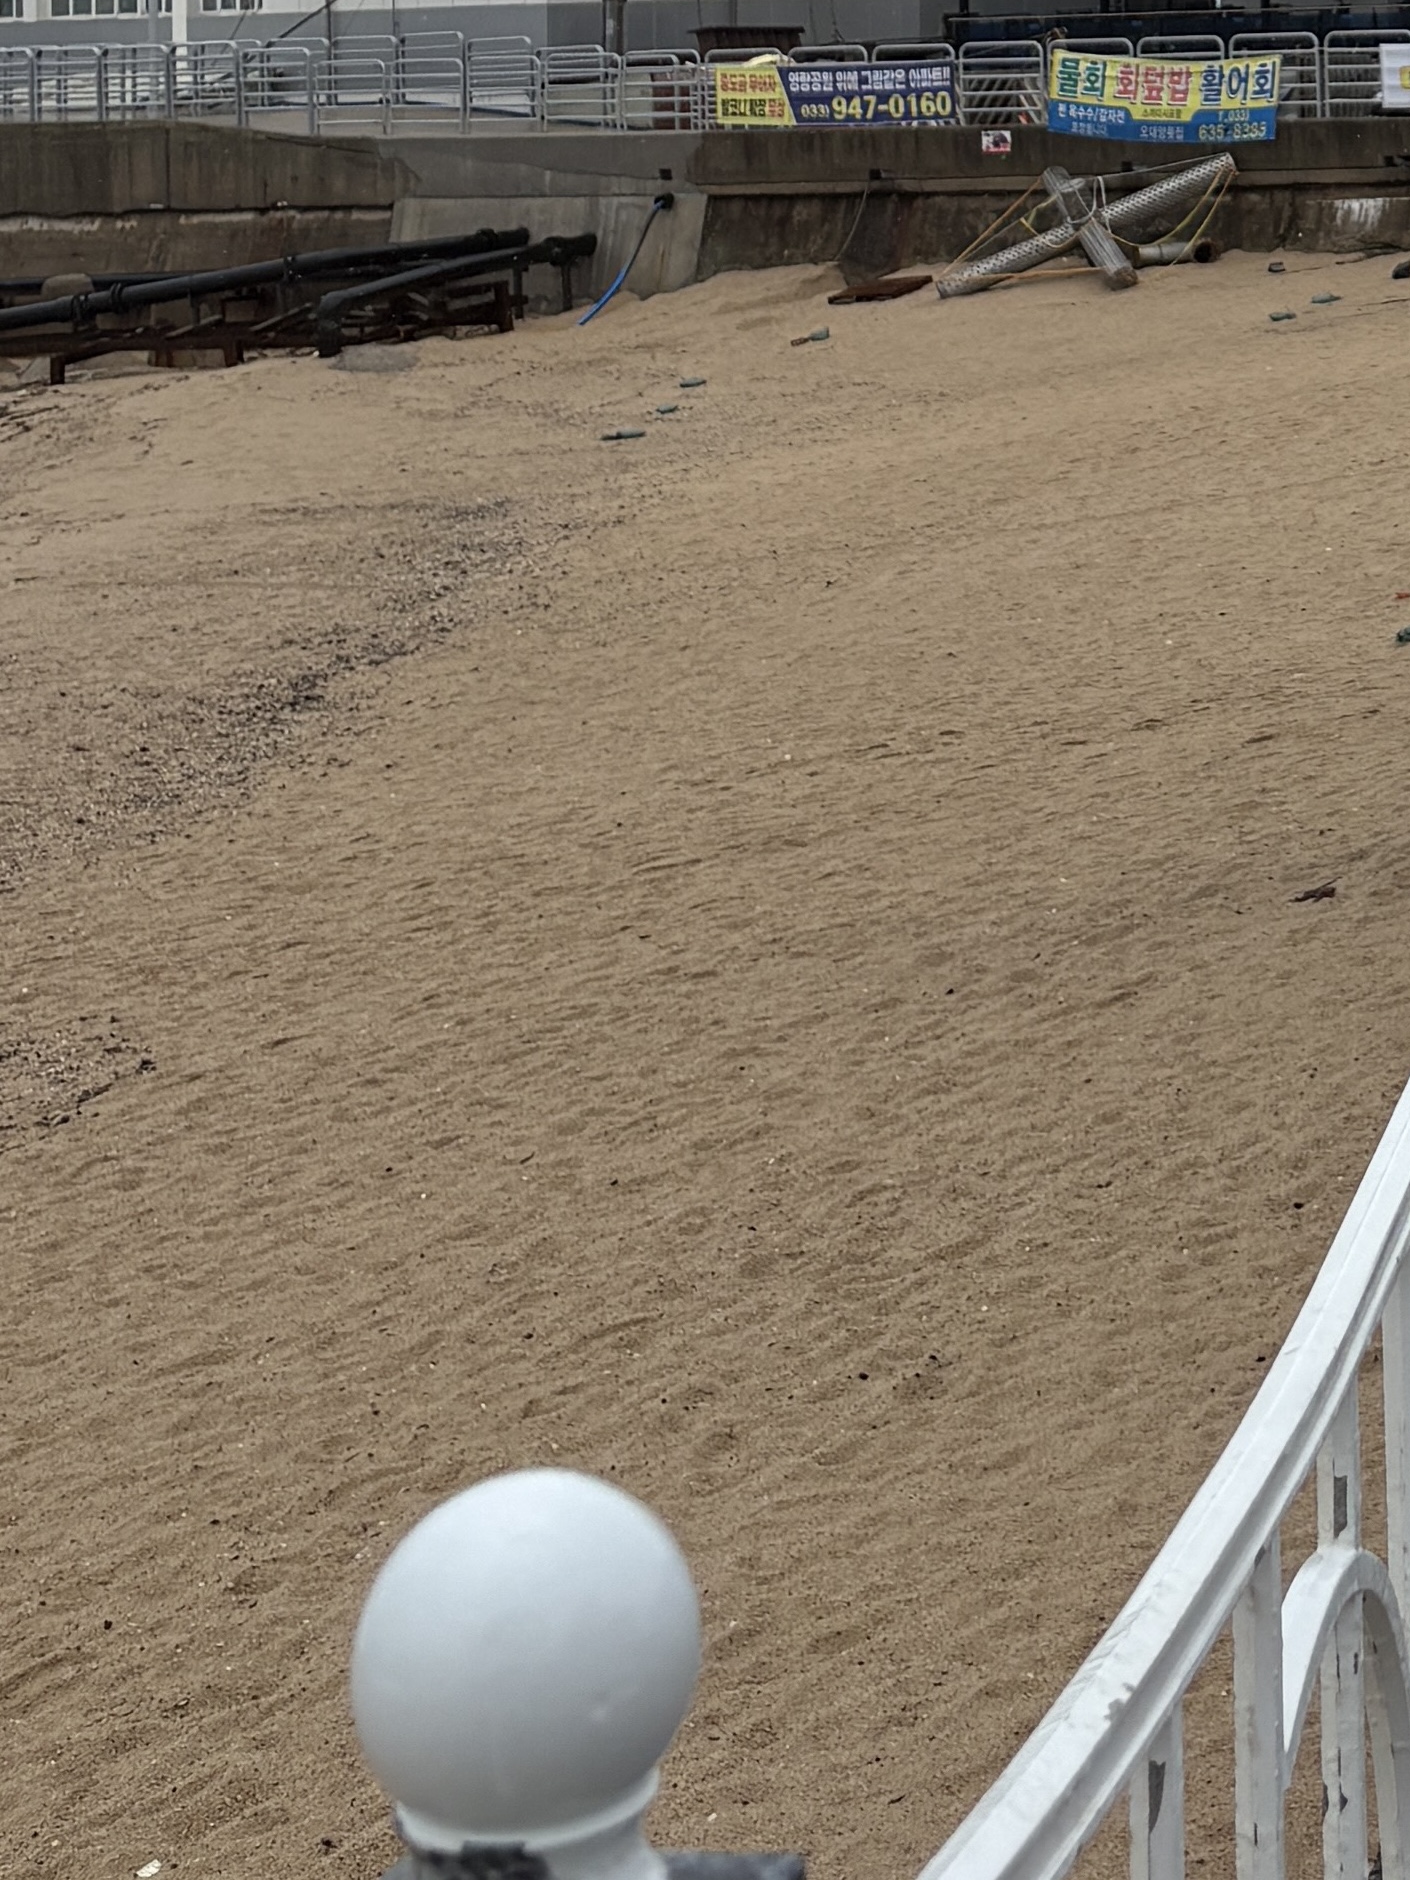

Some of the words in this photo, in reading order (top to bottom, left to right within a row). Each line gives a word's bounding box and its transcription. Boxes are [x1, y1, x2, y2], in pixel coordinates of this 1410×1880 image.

[1057, 56, 1107, 101] 물회
[1114, 62, 1192, 105] 회덮밥
[1200, 60, 1277, 105] 활어회
[831, 90, 951, 120] 947-0160
